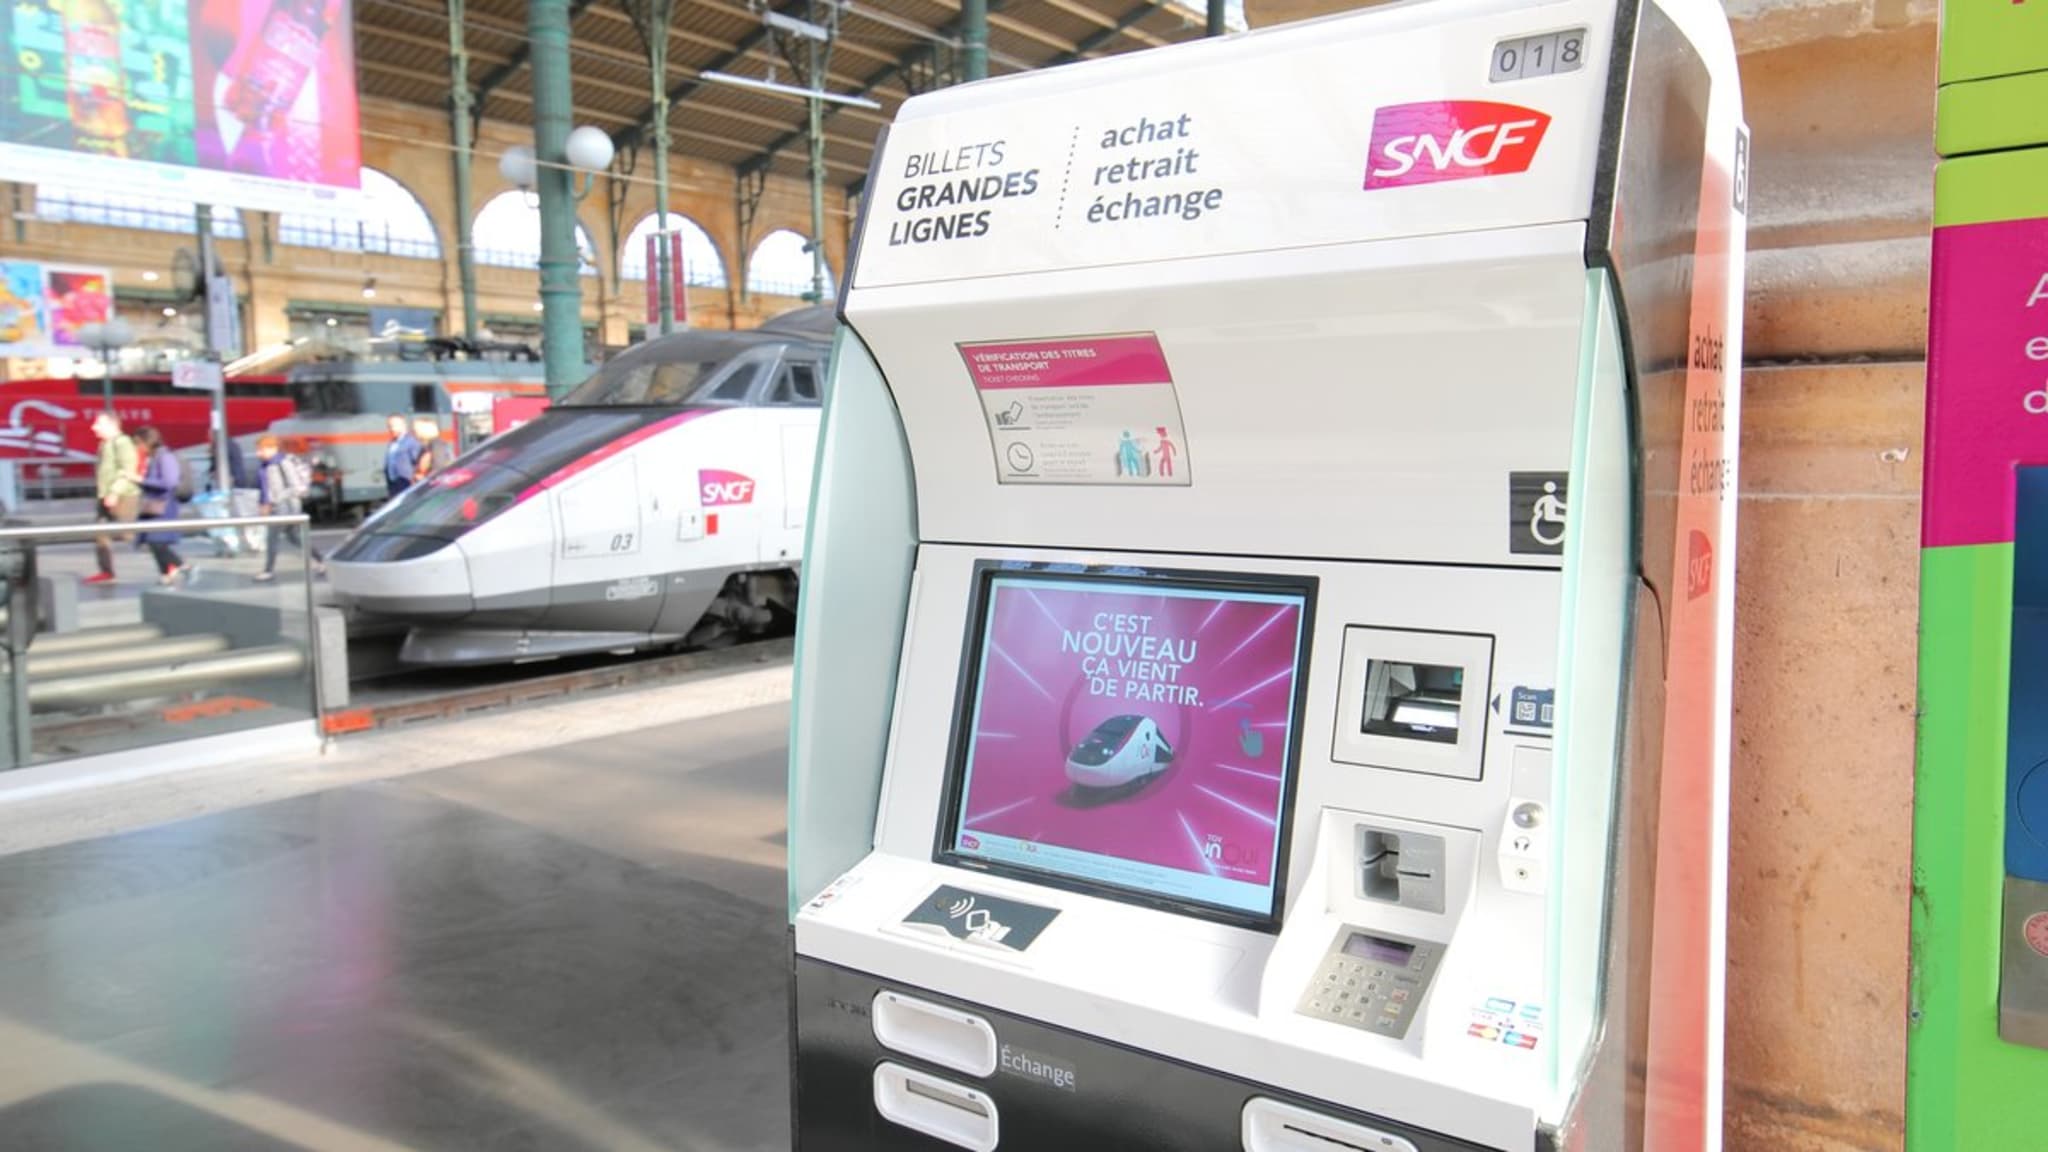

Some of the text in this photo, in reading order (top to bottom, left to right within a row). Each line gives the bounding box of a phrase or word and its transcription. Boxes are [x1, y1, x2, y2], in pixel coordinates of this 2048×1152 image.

[1499, 38, 1580, 73] 018
[1100, 112, 1192, 150] achat
[1372, 118, 1538, 178] SNCF
[903, 140, 1007, 179] BILLETS
[1093, 147, 1200, 187] retrait
[896, 168, 1040, 212] GRANDES
[1086, 187, 1223, 224] échange
[888, 209, 992, 246] LIGNES
[973, 348, 1097, 362] VÉRIFICATION DES TITRES
[1694, 325, 1723, 372] achat
[977, 361, 1050, 373] DE TRANSPORT
[702, 480, 753, 504] SNCF
[610, 533, 633, 552] 03
[1094, 612, 1153, 633] C'EST
[1061, 630, 1198, 664] NOUVEAU
[1081, 656, 1182, 683] ÇA VIENT
[1090, 677, 1204, 707] DE PARTIR.
[1001, 1045, 1075, 1086] Échange
